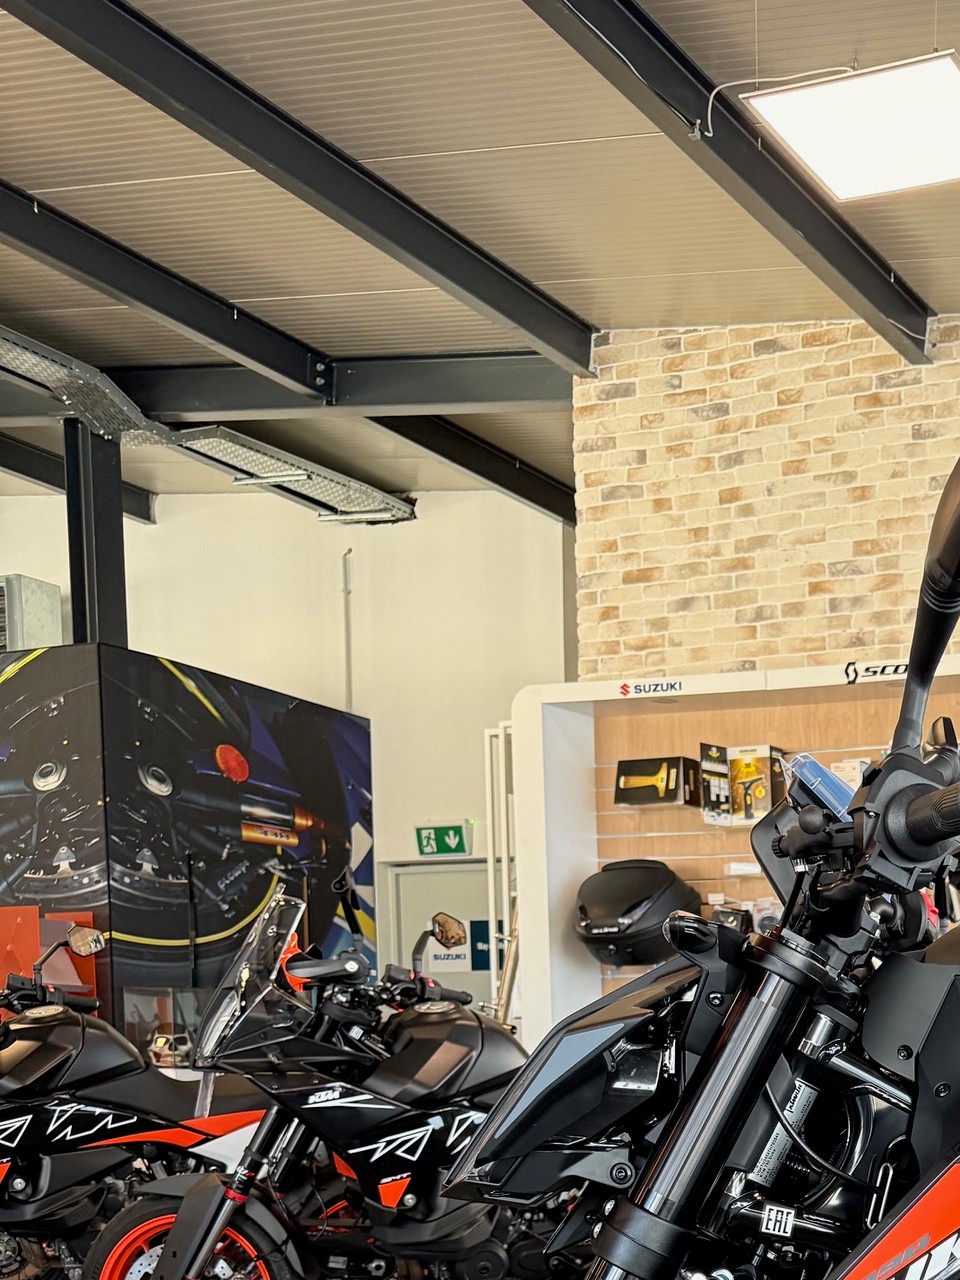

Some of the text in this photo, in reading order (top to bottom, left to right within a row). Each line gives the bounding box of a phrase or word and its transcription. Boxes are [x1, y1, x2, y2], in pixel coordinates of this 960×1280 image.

[861, 664, 909, 678] SCO
[633, 681, 682, 694] SUZUKI
[433, 953, 466, 961] SUZUKI
[308, 1089, 341, 1104] KTM
[764, 1207, 792, 1234] EAC
